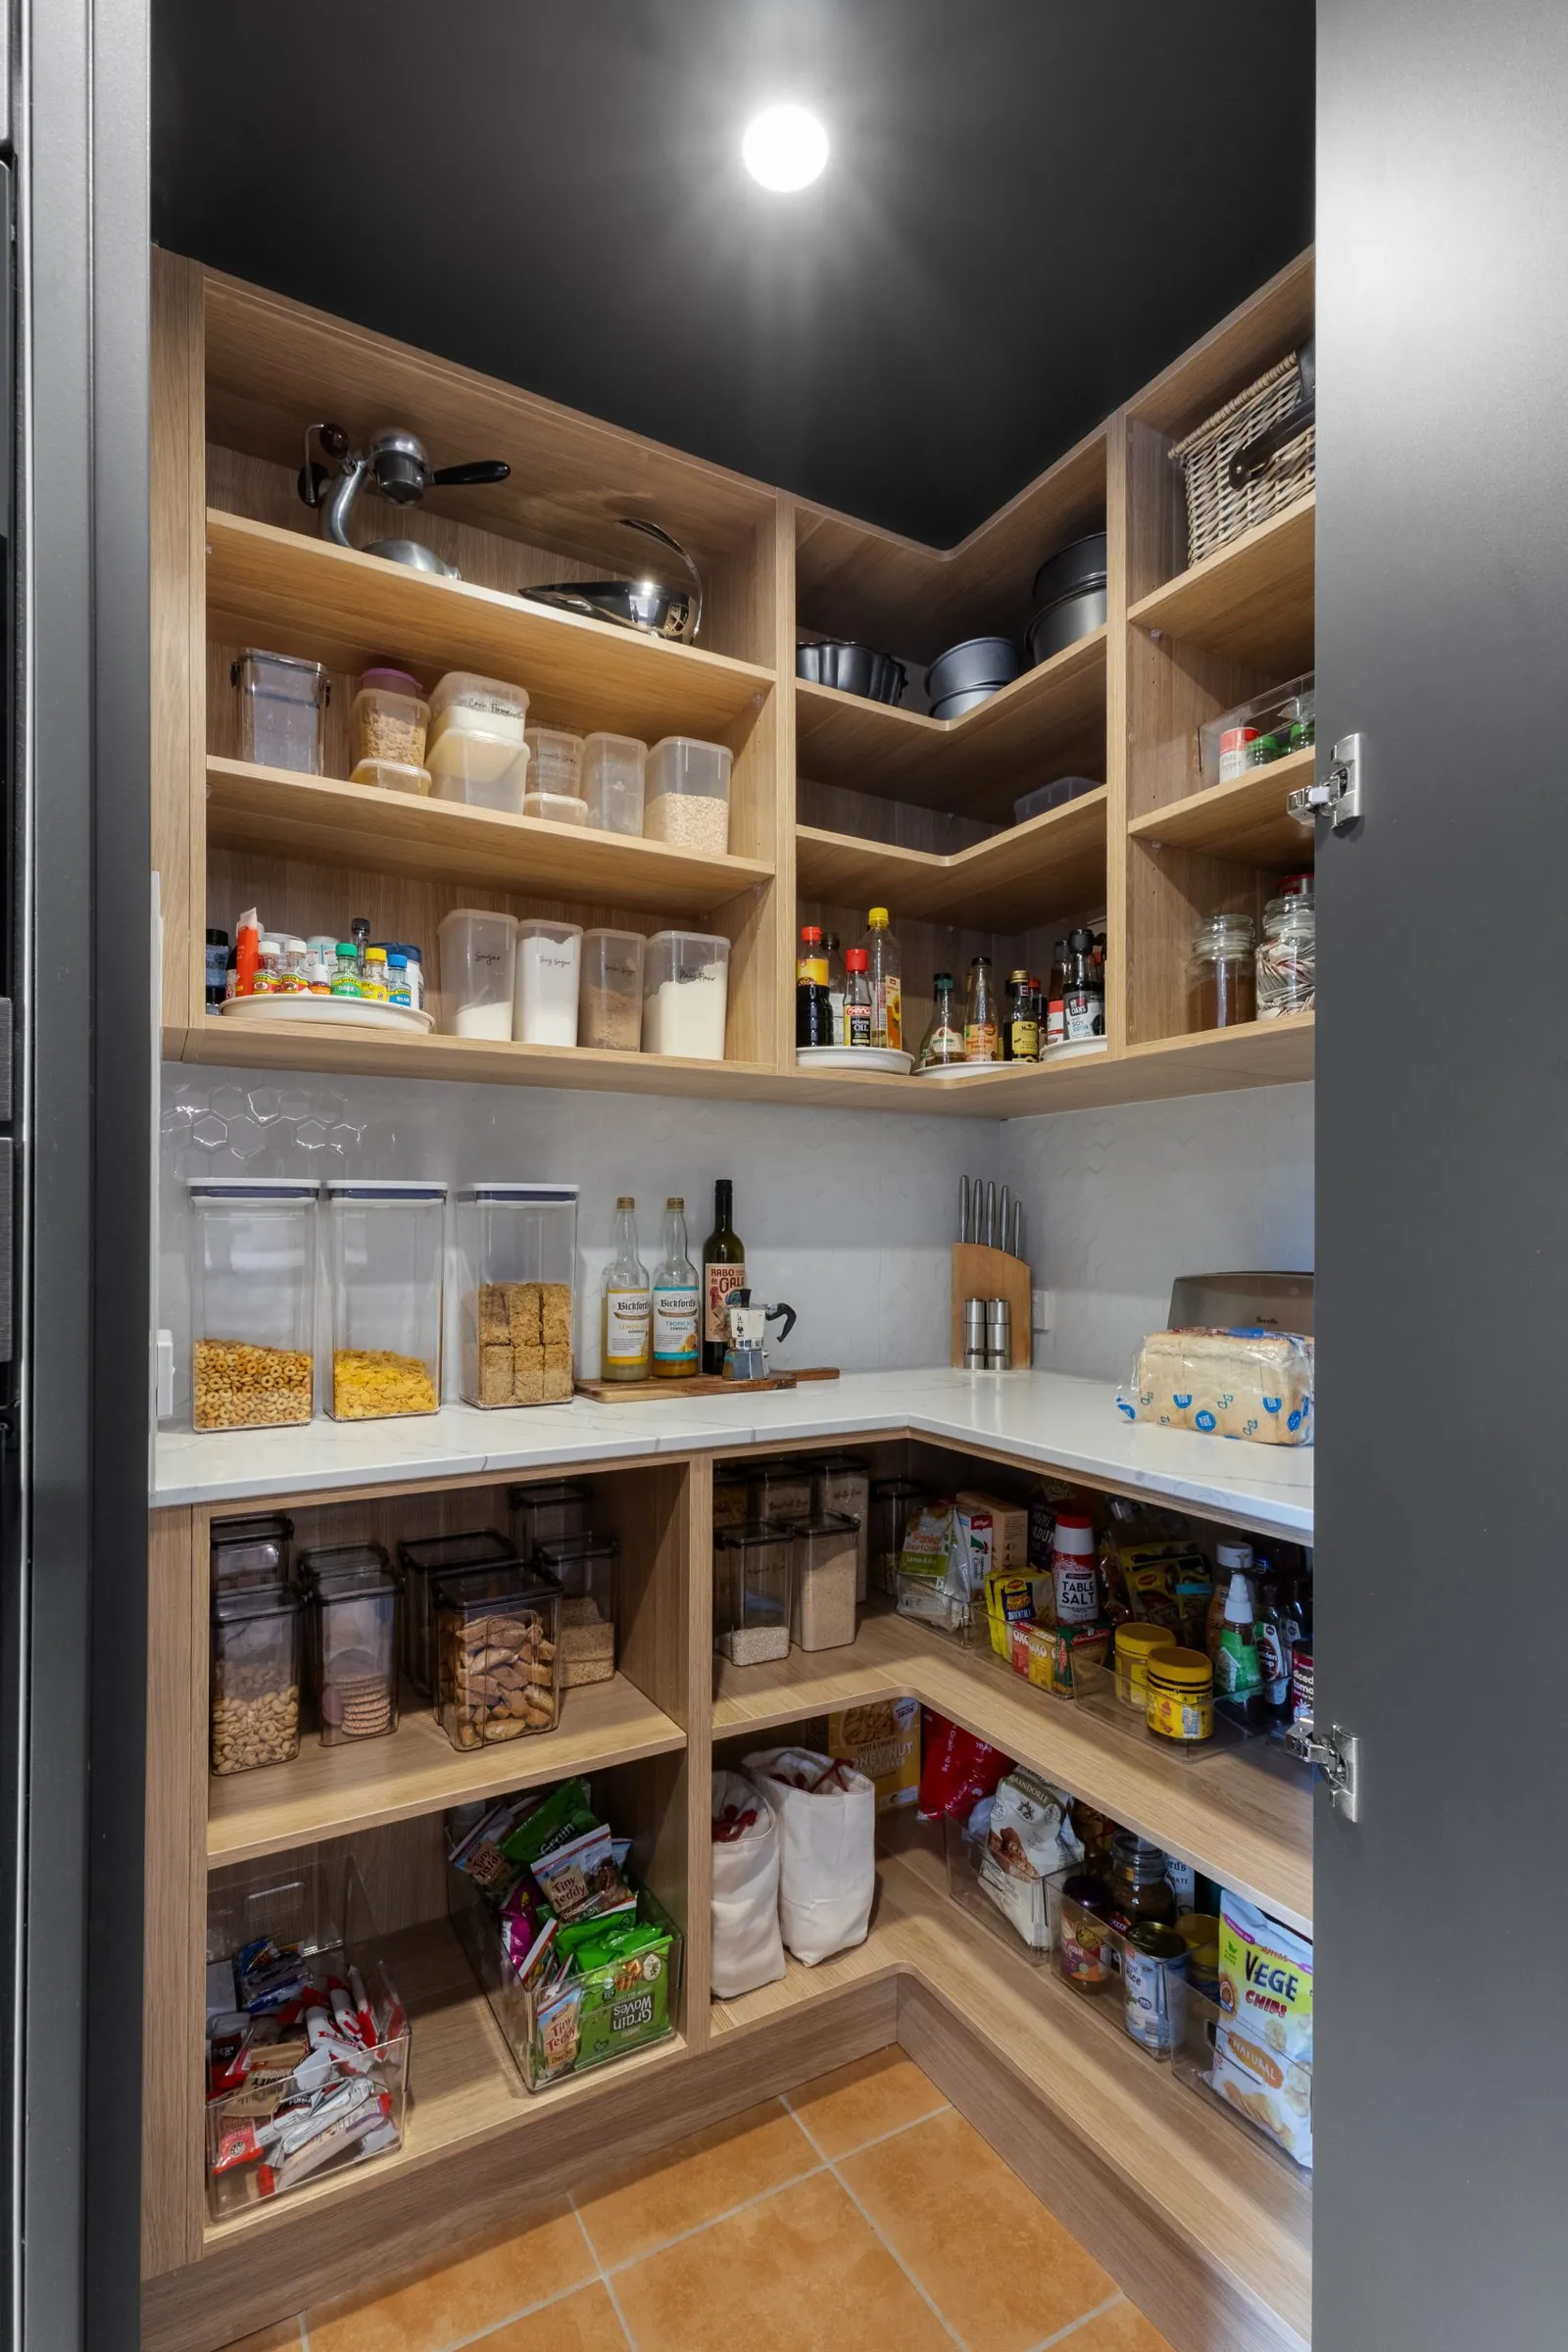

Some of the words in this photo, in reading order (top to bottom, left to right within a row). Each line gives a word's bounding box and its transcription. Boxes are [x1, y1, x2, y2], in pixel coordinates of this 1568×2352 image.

[474, 951, 502, 965] Sugar
[710, 1268, 735, 1277] RABO
[1062, 1581, 1095, 1592] TABLE
[1062, 1592, 1095, 1605] SALT
[1029, 1642, 1047, 1658] OXO
[898, 1707, 914, 1719] IRON
[947, 1730, 956, 1751] Grain
[851, 1750, 885, 1770] ONEY
[890, 1741, 913, 1759] NUT
[552, 1875, 576, 1893] Tiny
[554, 1885, 586, 1908] Teddy
[1126, 1966, 1142, 1986] Rice
[1246, 1948, 1298, 2002] VEGE
[612, 1995, 653, 2016] Waves
[1246, 1989, 1288, 2019] CHIPS
[551, 2016, 572, 2038] Tiny
[612, 2009, 653, 2031] Grain
[546, 2026, 576, 2051] Teddy
[1233, 2039, 1277, 2082] NATURAL
